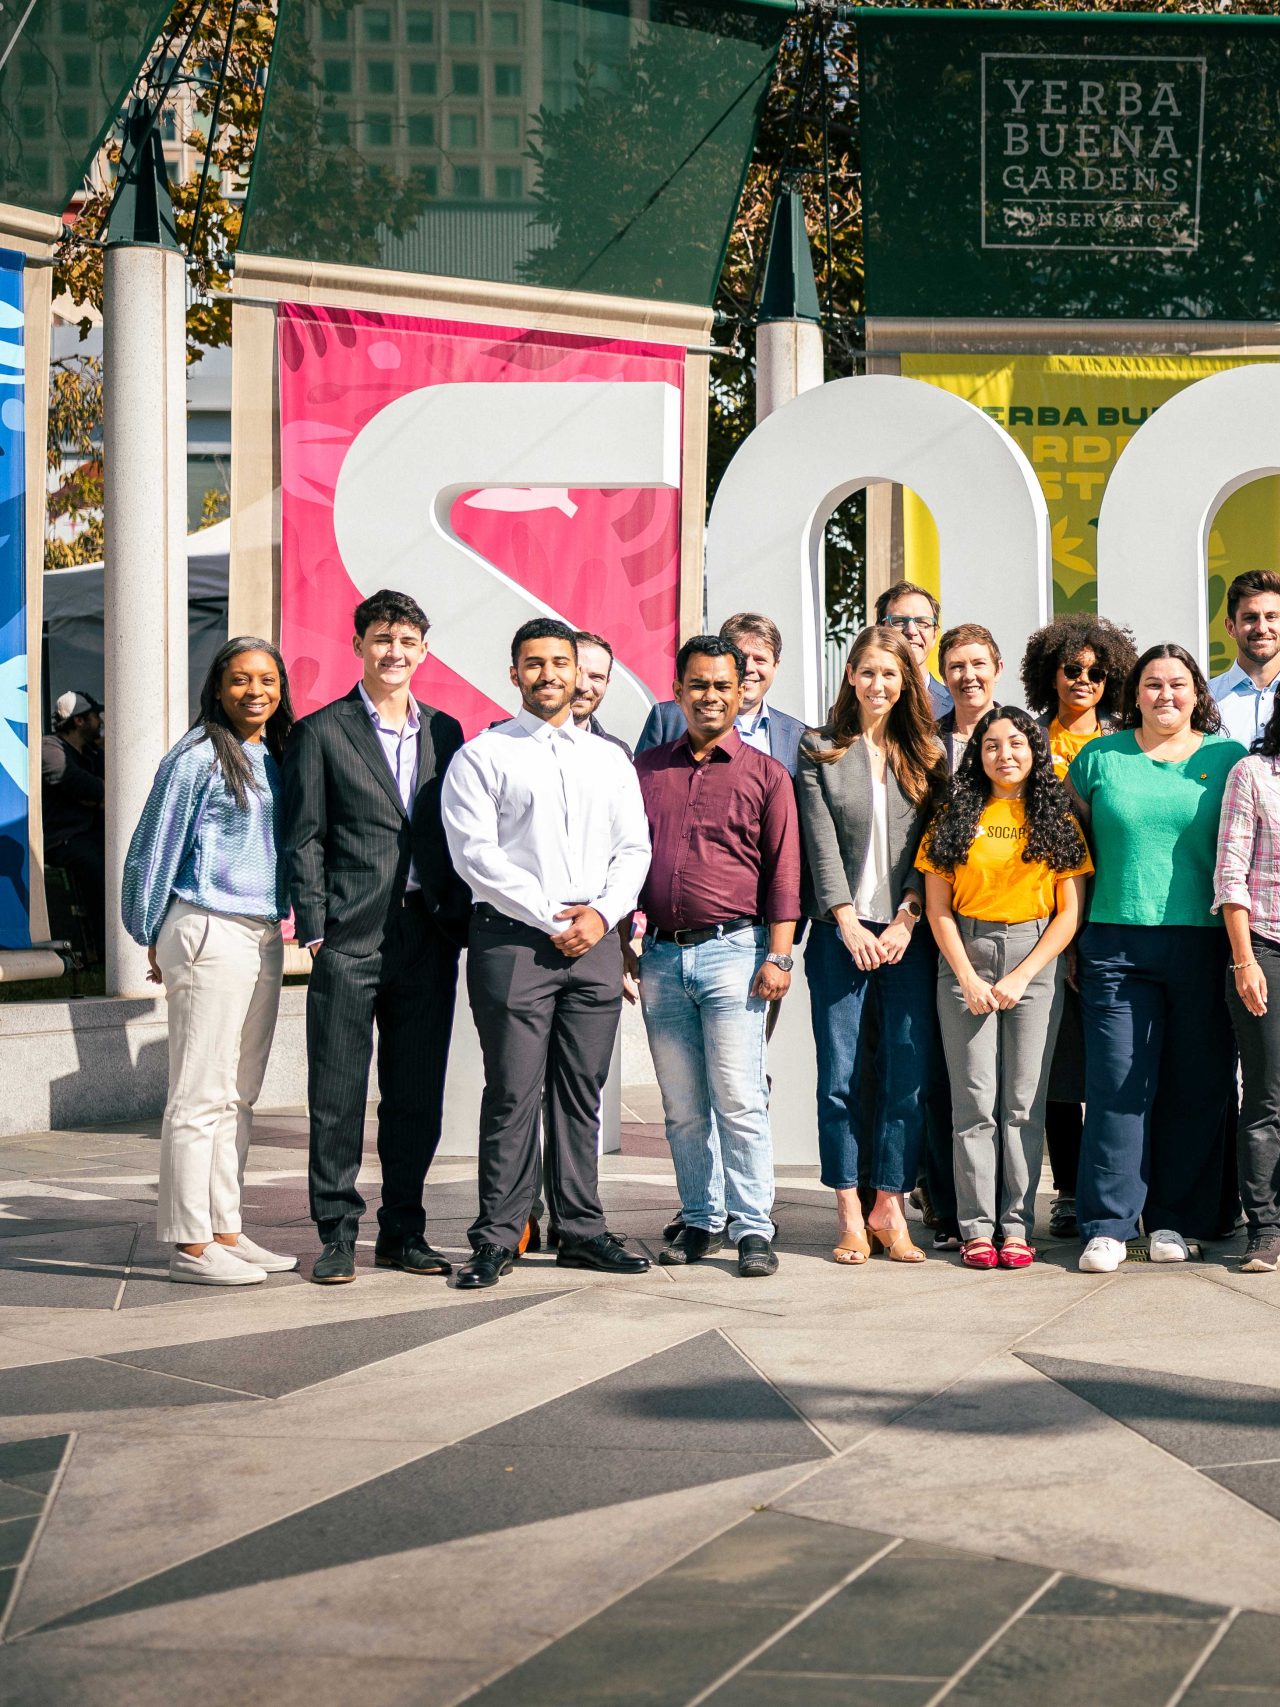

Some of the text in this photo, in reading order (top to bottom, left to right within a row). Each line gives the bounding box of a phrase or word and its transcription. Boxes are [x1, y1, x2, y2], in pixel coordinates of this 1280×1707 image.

[1003, 79, 1182, 116] YERBA
[1003, 122, 1181, 158] BUENA
[1003, 165, 1178, 192] GARDENS
[1003, 212, 1177, 228] CONSERVANCY
[982, 406, 1088, 426] ERBA
[987, 826, 1025, 839] SOCAP
